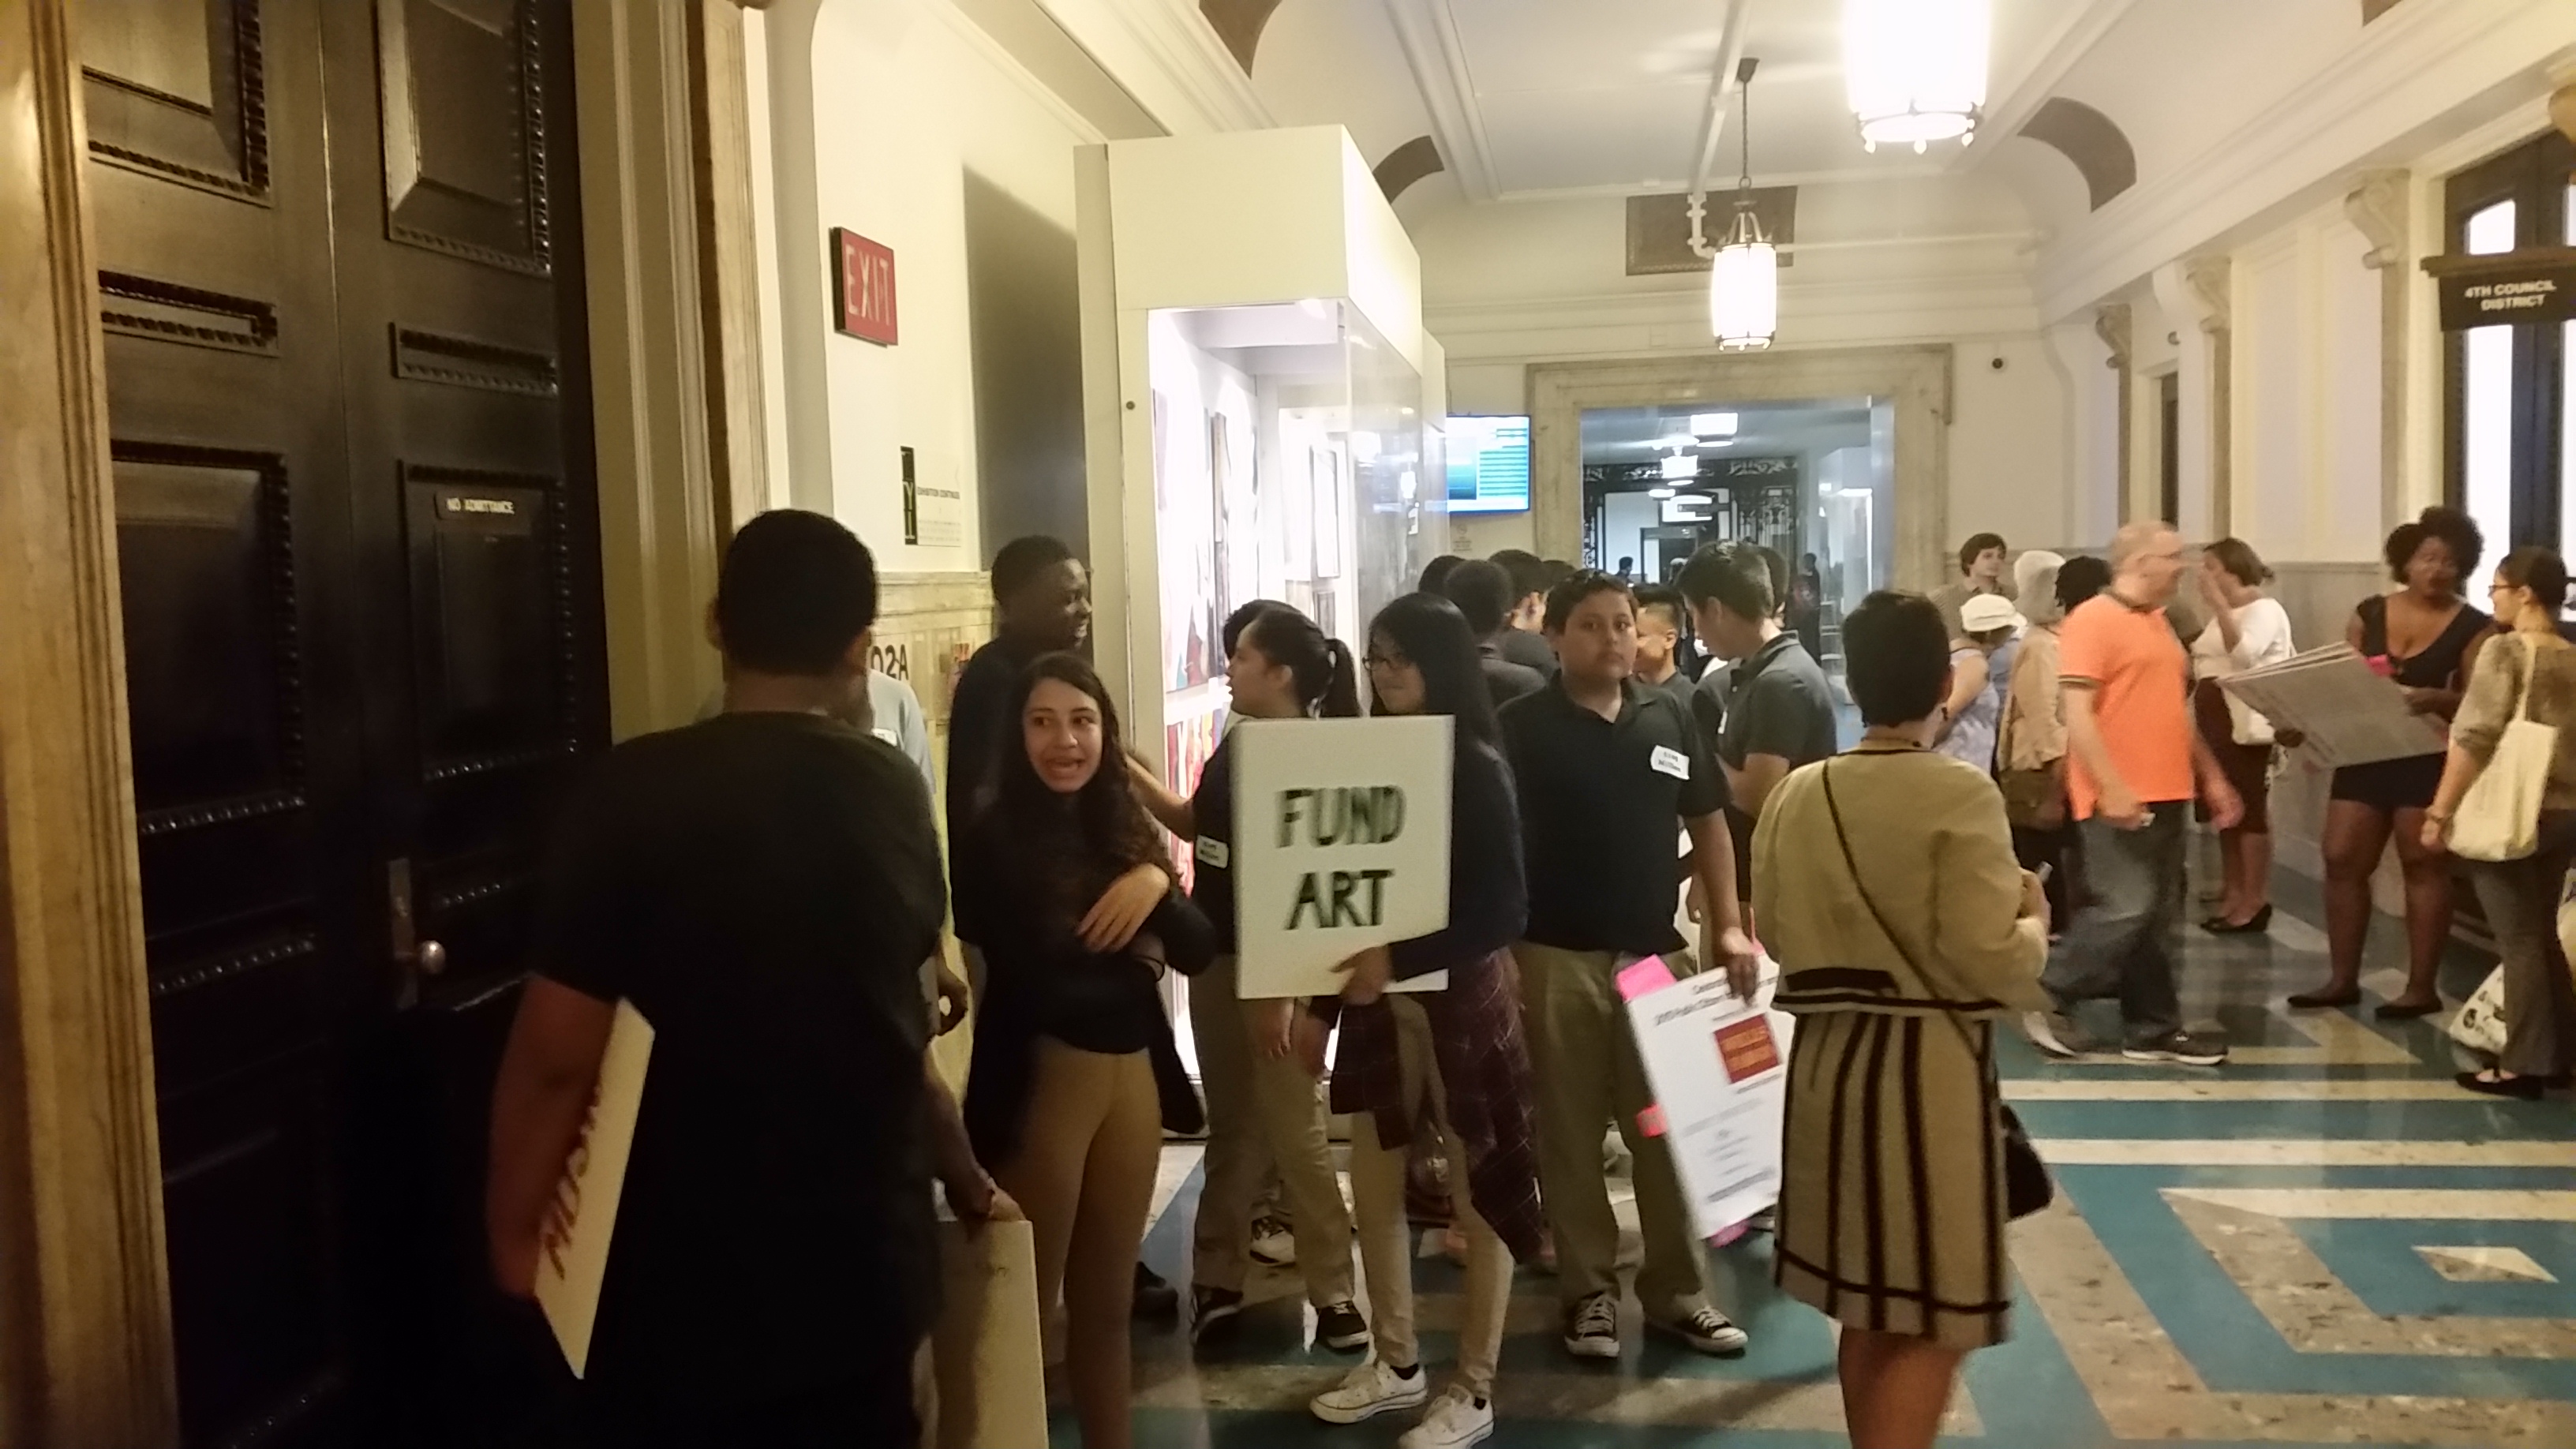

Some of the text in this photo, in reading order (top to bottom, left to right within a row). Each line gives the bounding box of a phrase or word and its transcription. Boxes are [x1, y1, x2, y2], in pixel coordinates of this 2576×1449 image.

[845, 244, 889, 326] EXIT
[2465, 280, 2557, 298] 4TH COUNCIL
[2481, 294, 2546, 311] DISTRICT
[447, 498, 461, 512] NO
[1275, 785, 1407, 848] FUND
[1282, 869, 1395, 930] ART
